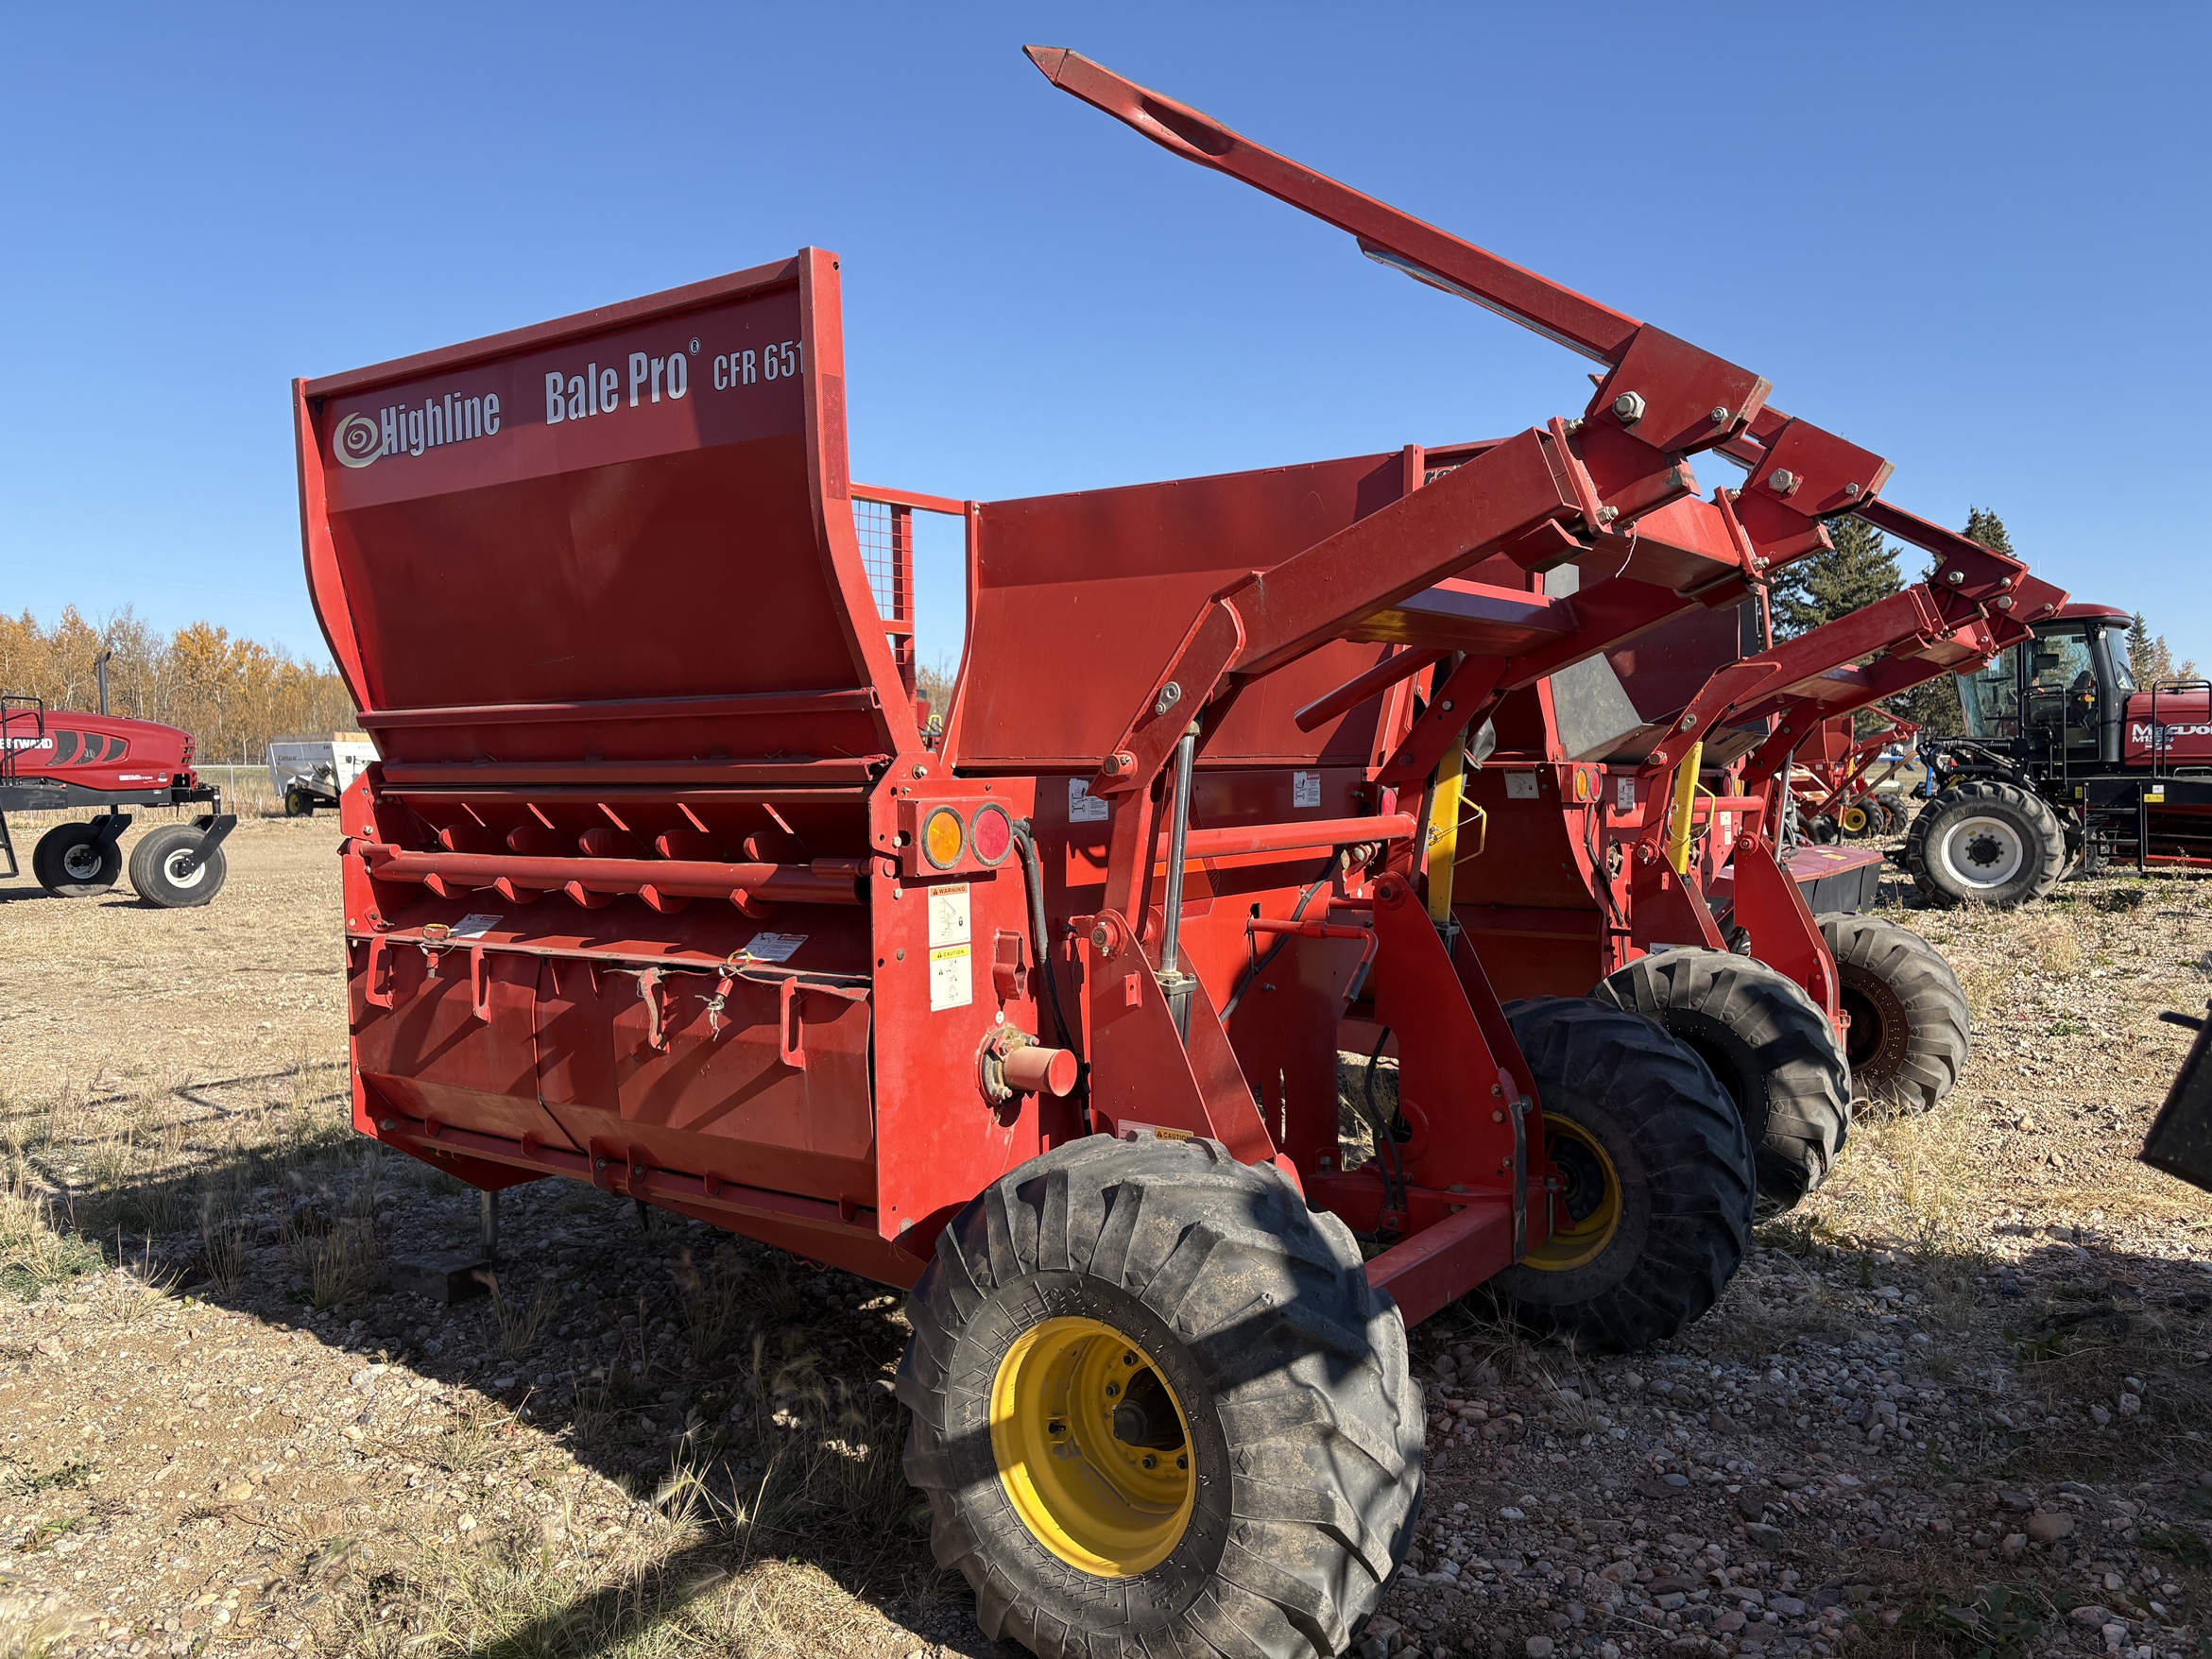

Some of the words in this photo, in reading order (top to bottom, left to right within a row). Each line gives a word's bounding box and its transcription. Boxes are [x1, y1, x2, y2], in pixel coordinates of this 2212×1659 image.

[713, 349, 756, 391] CFR
[763, 340, 803, 382] 651
[544, 362, 619, 425] Bale
[380, 391, 500, 457] Highline
[0, 738, 53, 749] ESTWARD
[2132, 723, 2212, 736] MacDo
